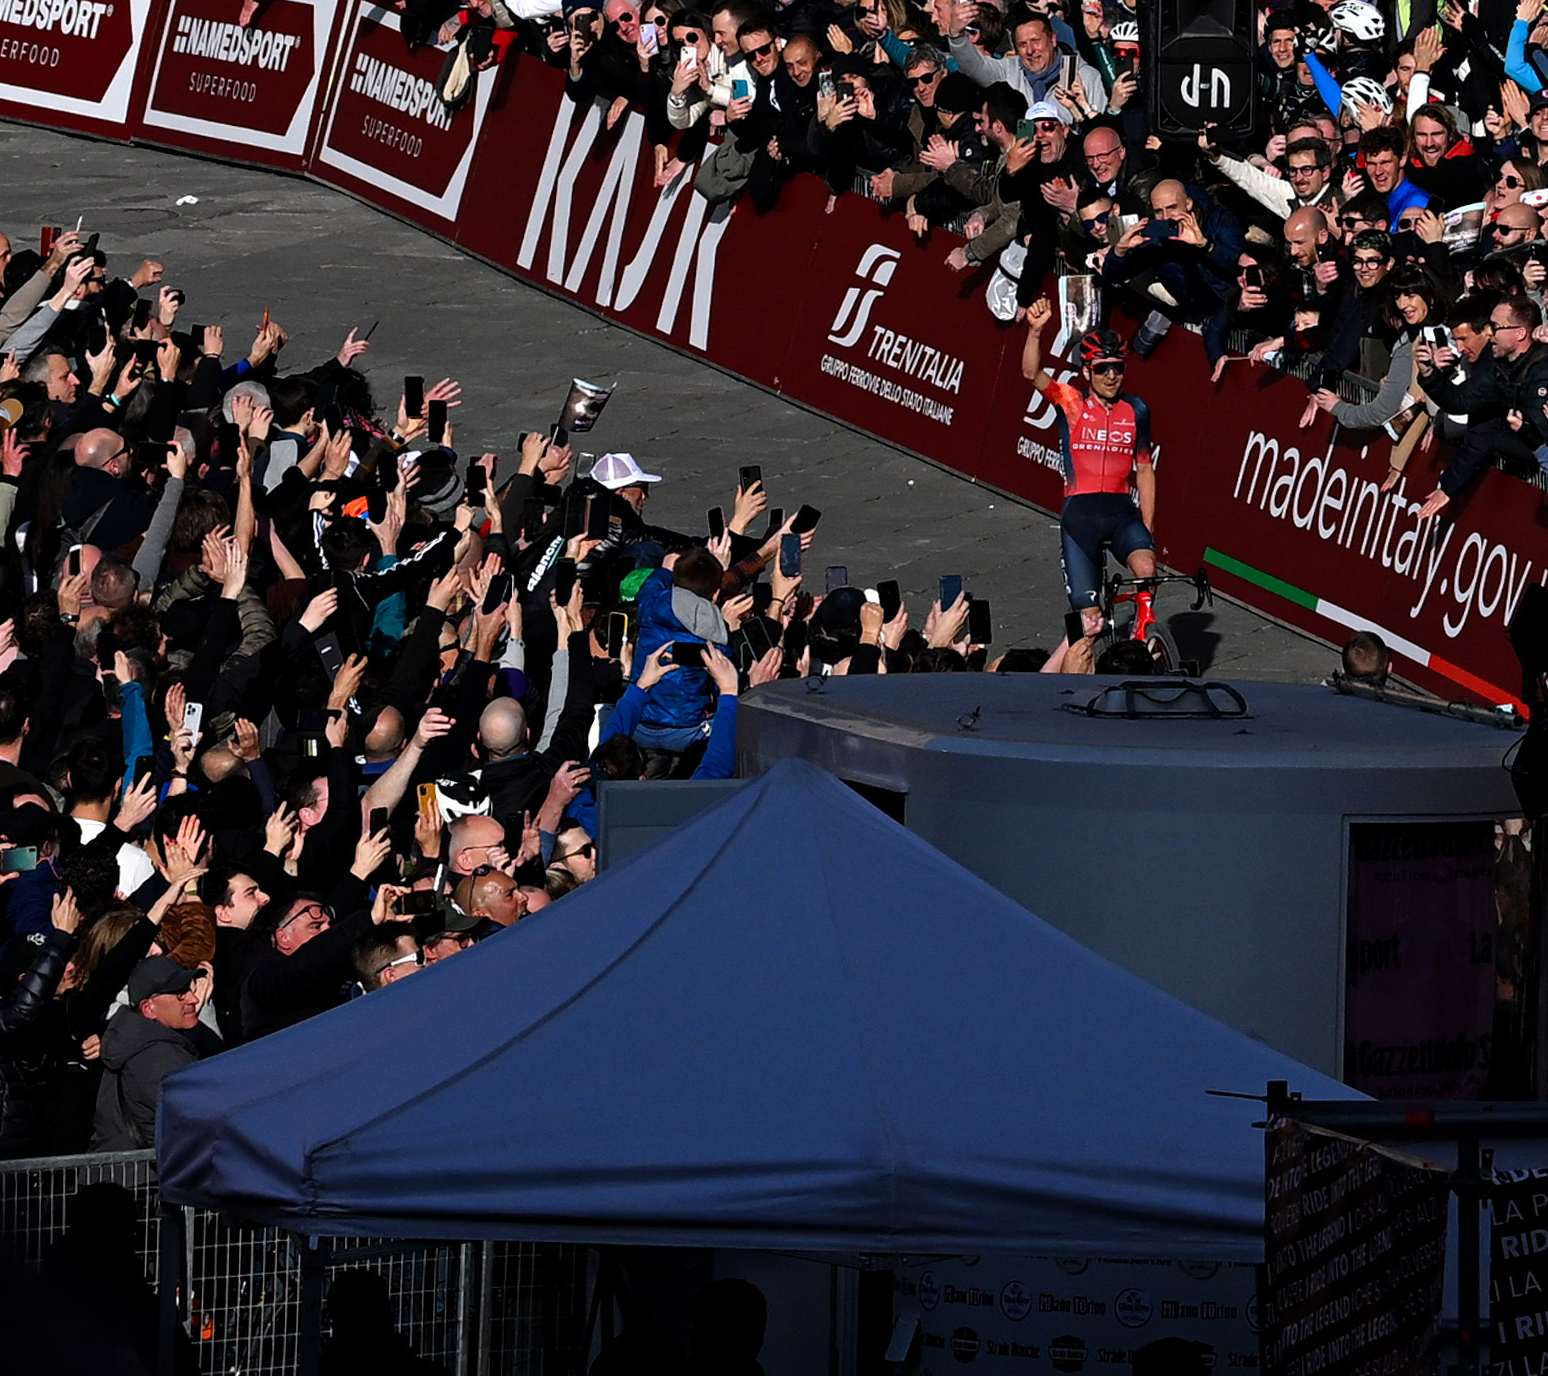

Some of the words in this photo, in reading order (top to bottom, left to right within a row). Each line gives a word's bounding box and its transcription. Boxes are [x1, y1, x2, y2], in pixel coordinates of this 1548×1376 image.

[188, 71, 257, 104] SUPERFOOD
[361, 114, 423, 158] SUPERFOOD
[867, 325, 965, 395] TRENITALIA
[820, 353, 850, 381] GRUPPO
[848, 365, 881, 395] FERROVIE
[879, 379, 903, 404] DELLO
[900, 389, 924, 413] STATO
[922, 398, 954, 426] ITALIANE
[1017, 436, 1045, 464] GRUPPO
[1081, 427, 1133, 444] INEOS
[1508, 1270, 1543, 1299] LA
